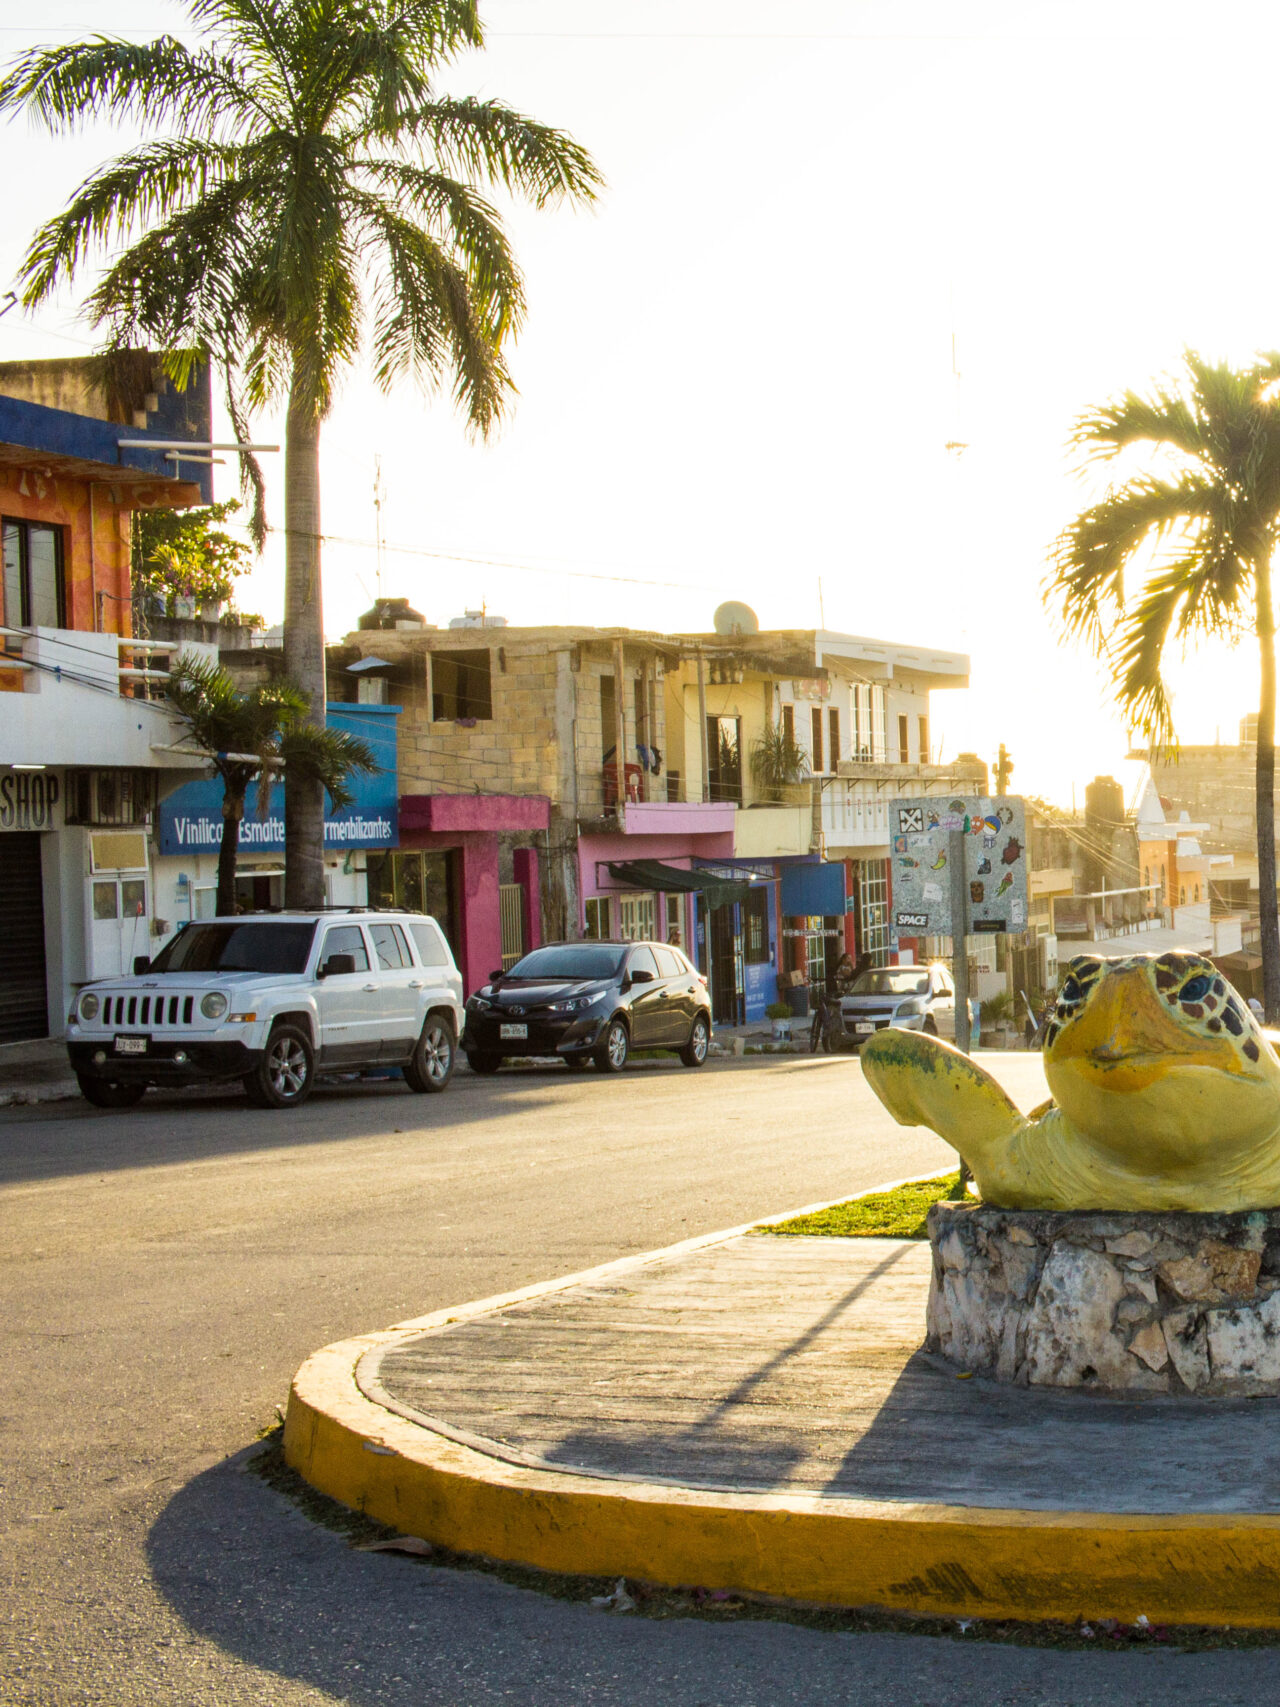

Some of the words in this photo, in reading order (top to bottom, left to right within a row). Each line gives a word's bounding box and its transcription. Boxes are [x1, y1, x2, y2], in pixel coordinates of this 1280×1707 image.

[0, 773, 59, 830] SHOP
[174, 817, 224, 844] Vinilica
[238, 817, 285, 843] Esmalte
[898, 915, 926, 925] SPACE
